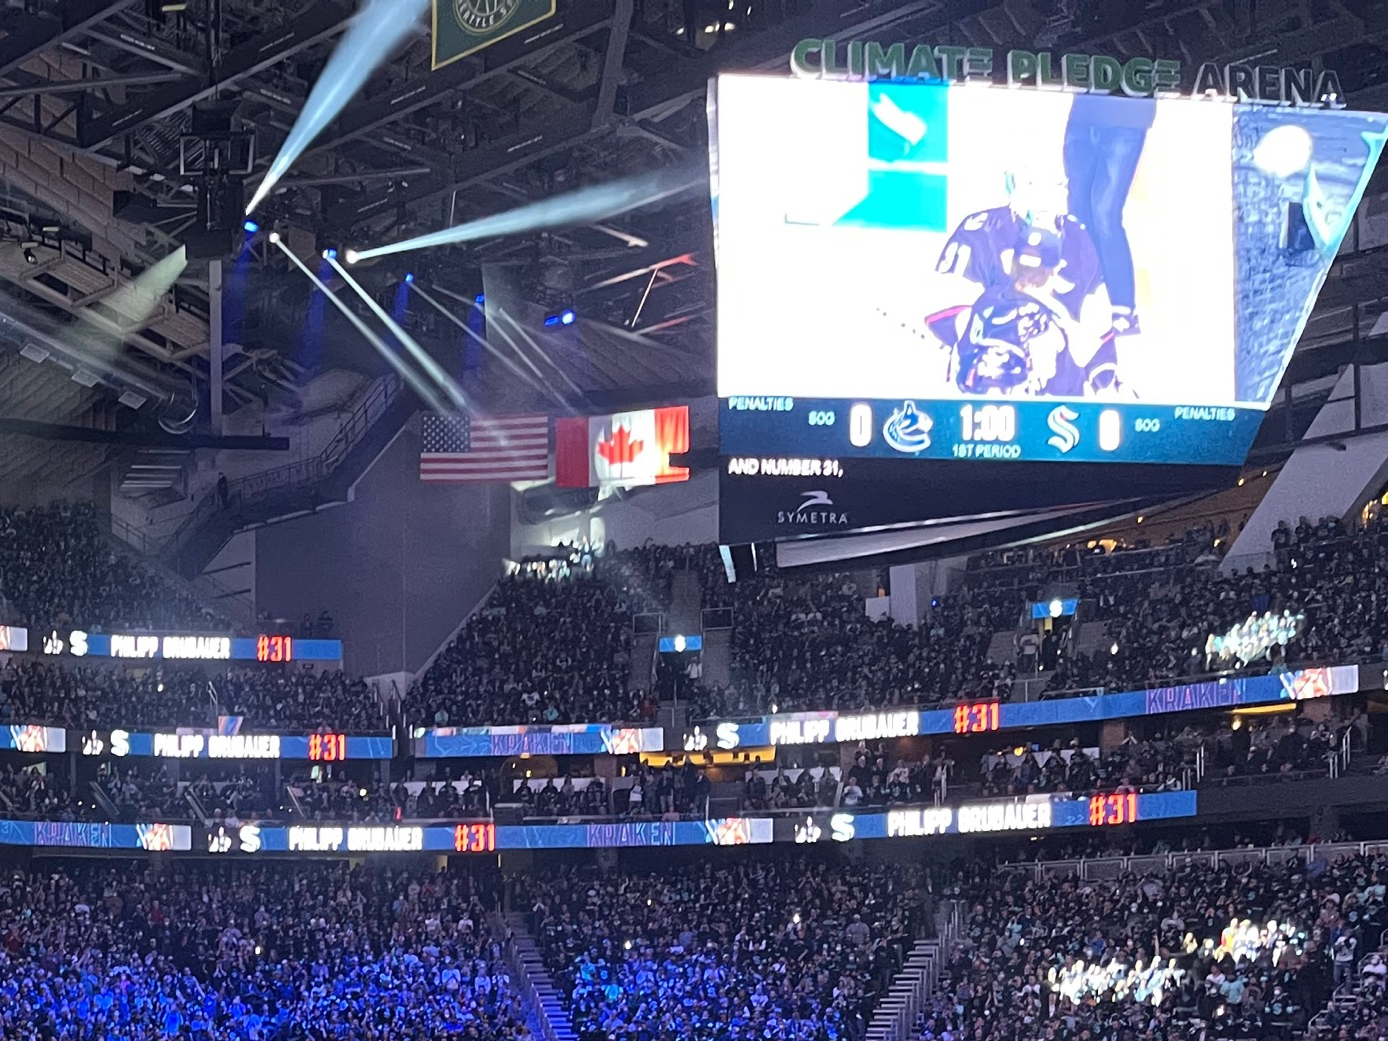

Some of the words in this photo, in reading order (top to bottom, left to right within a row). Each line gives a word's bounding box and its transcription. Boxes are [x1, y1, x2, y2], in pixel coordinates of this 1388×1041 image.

[790, 38, 993, 86] CLIMATE
[1007, 50, 1181, 98] PLEDGE
[1192, 62, 1347, 108] ARENA
[728, 397, 794, 411] PENALTIES
[1175, 406, 1235, 421] PENALTIES
[849, 403, 873, 447] 0
[975, 445, 1021, 458] PERIOD
[761, 459, 821, 476] NUMBER
[777, 511, 848, 525] SYMETRA
[257, 635, 293, 663] #31
[954, 702, 1000, 733] #31
[308, 734, 347, 761] #31
[1089, 793, 1137, 826] #31
[455, 823, 496, 853] #31
